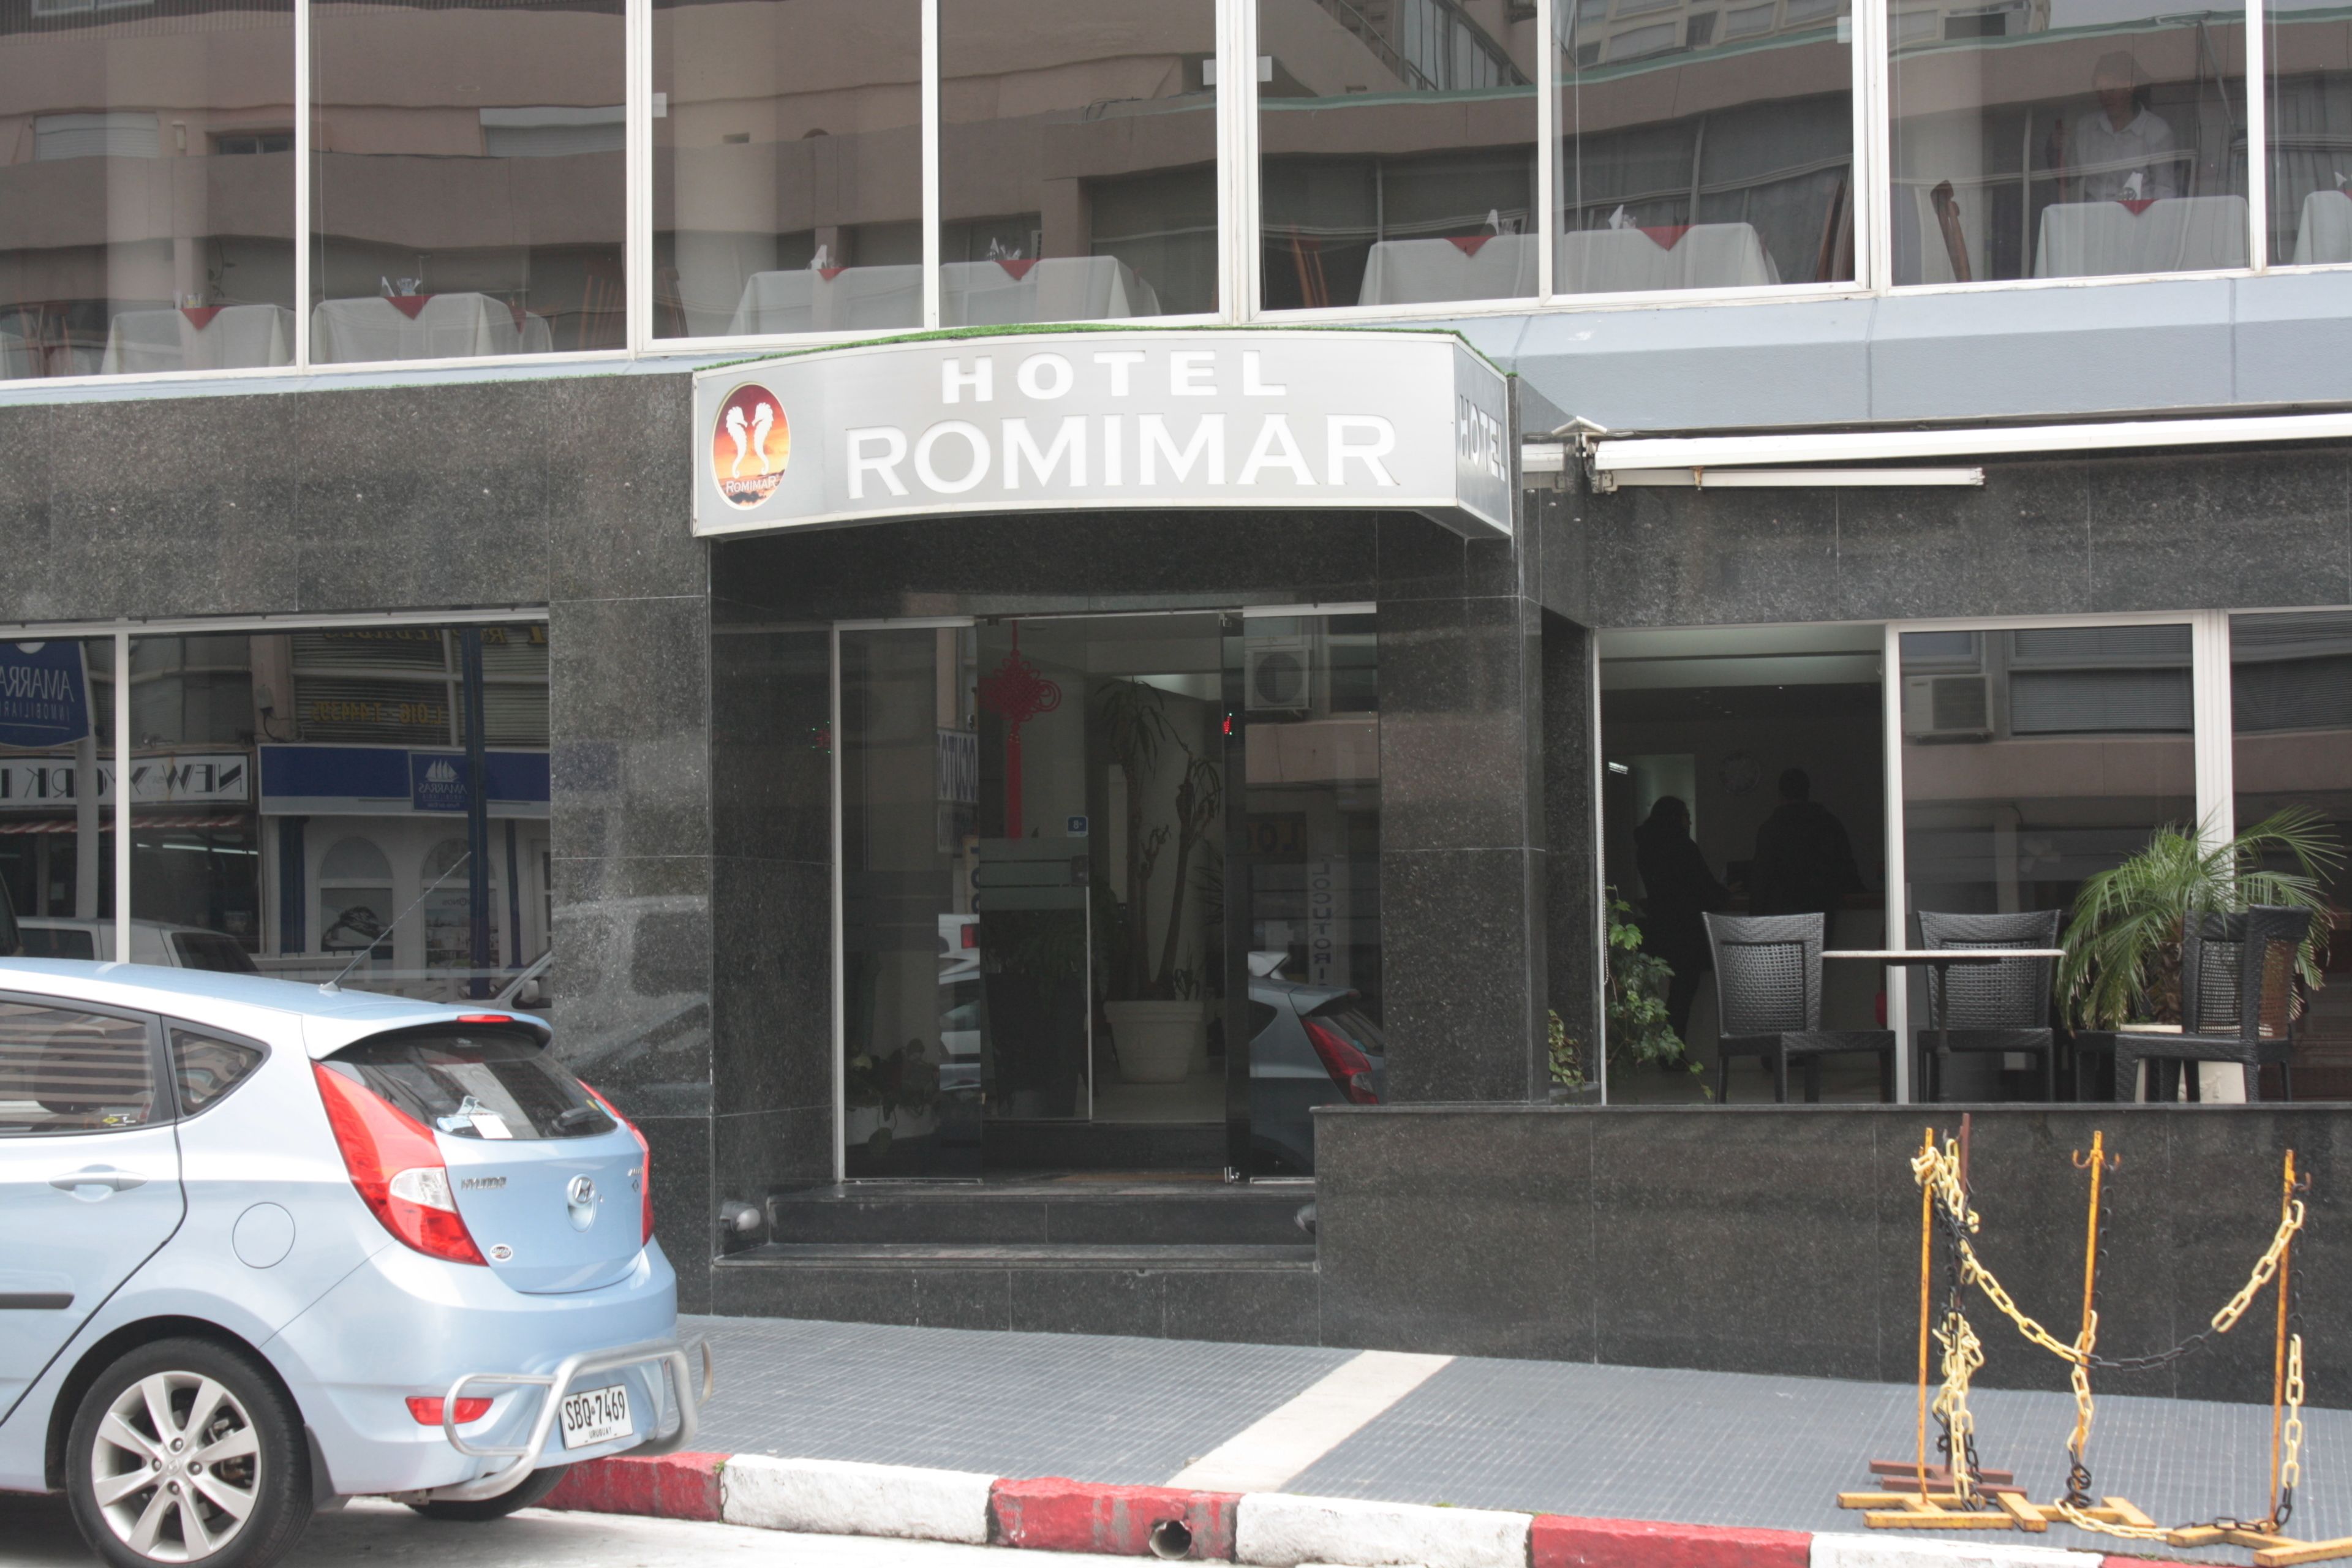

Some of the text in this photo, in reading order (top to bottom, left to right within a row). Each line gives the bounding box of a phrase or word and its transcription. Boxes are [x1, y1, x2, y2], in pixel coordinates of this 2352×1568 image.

[941, 349, 1287, 404] HOTEL
[845, 412, 1401, 499] ROMIMAR
[1460, 394, 1505, 482] HOTEL
[726, 475, 777, 493] ROMIMAR
[565, 1390, 625, 1431] SBQ 7469
[589, 1427, 612, 1439] URUGUAY
